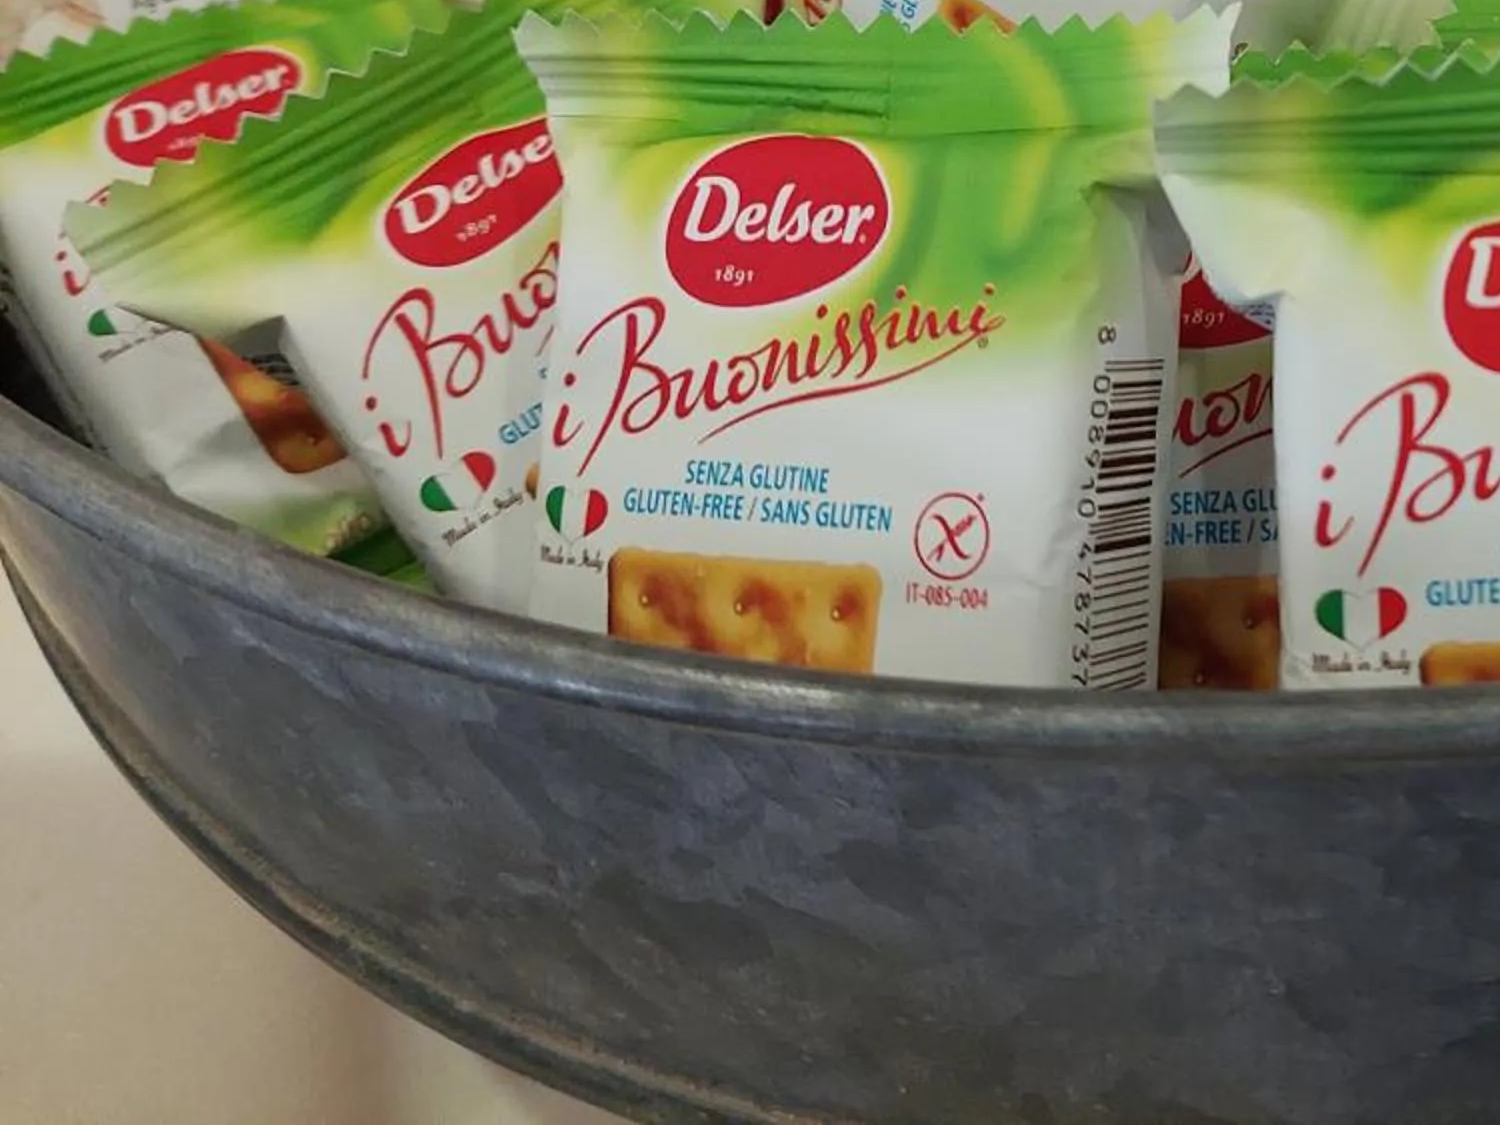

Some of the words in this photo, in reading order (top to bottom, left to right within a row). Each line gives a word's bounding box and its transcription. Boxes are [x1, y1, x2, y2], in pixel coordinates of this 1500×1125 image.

[113, 63, 290, 145] Delser
[392, 132, 554, 235] Delse
[682, 175, 876, 245] Delser
[714, 265, 755, 286] 1891
[1182, 310, 1226, 331] 1891
[552, 371, 584, 448] i
[576, 283, 1006, 478] Buonissimi
[685, 459, 744, 488] SENZA
[748, 463, 830, 495] GLUTINE
[1169, 488, 1238, 516] SENZA
[1314, 463, 1354, 548] i
[622, 486, 744, 521] GLUTEN-FREE
[759, 496, 811, 528] SANS
[815, 502, 893, 533] GLUTEN
